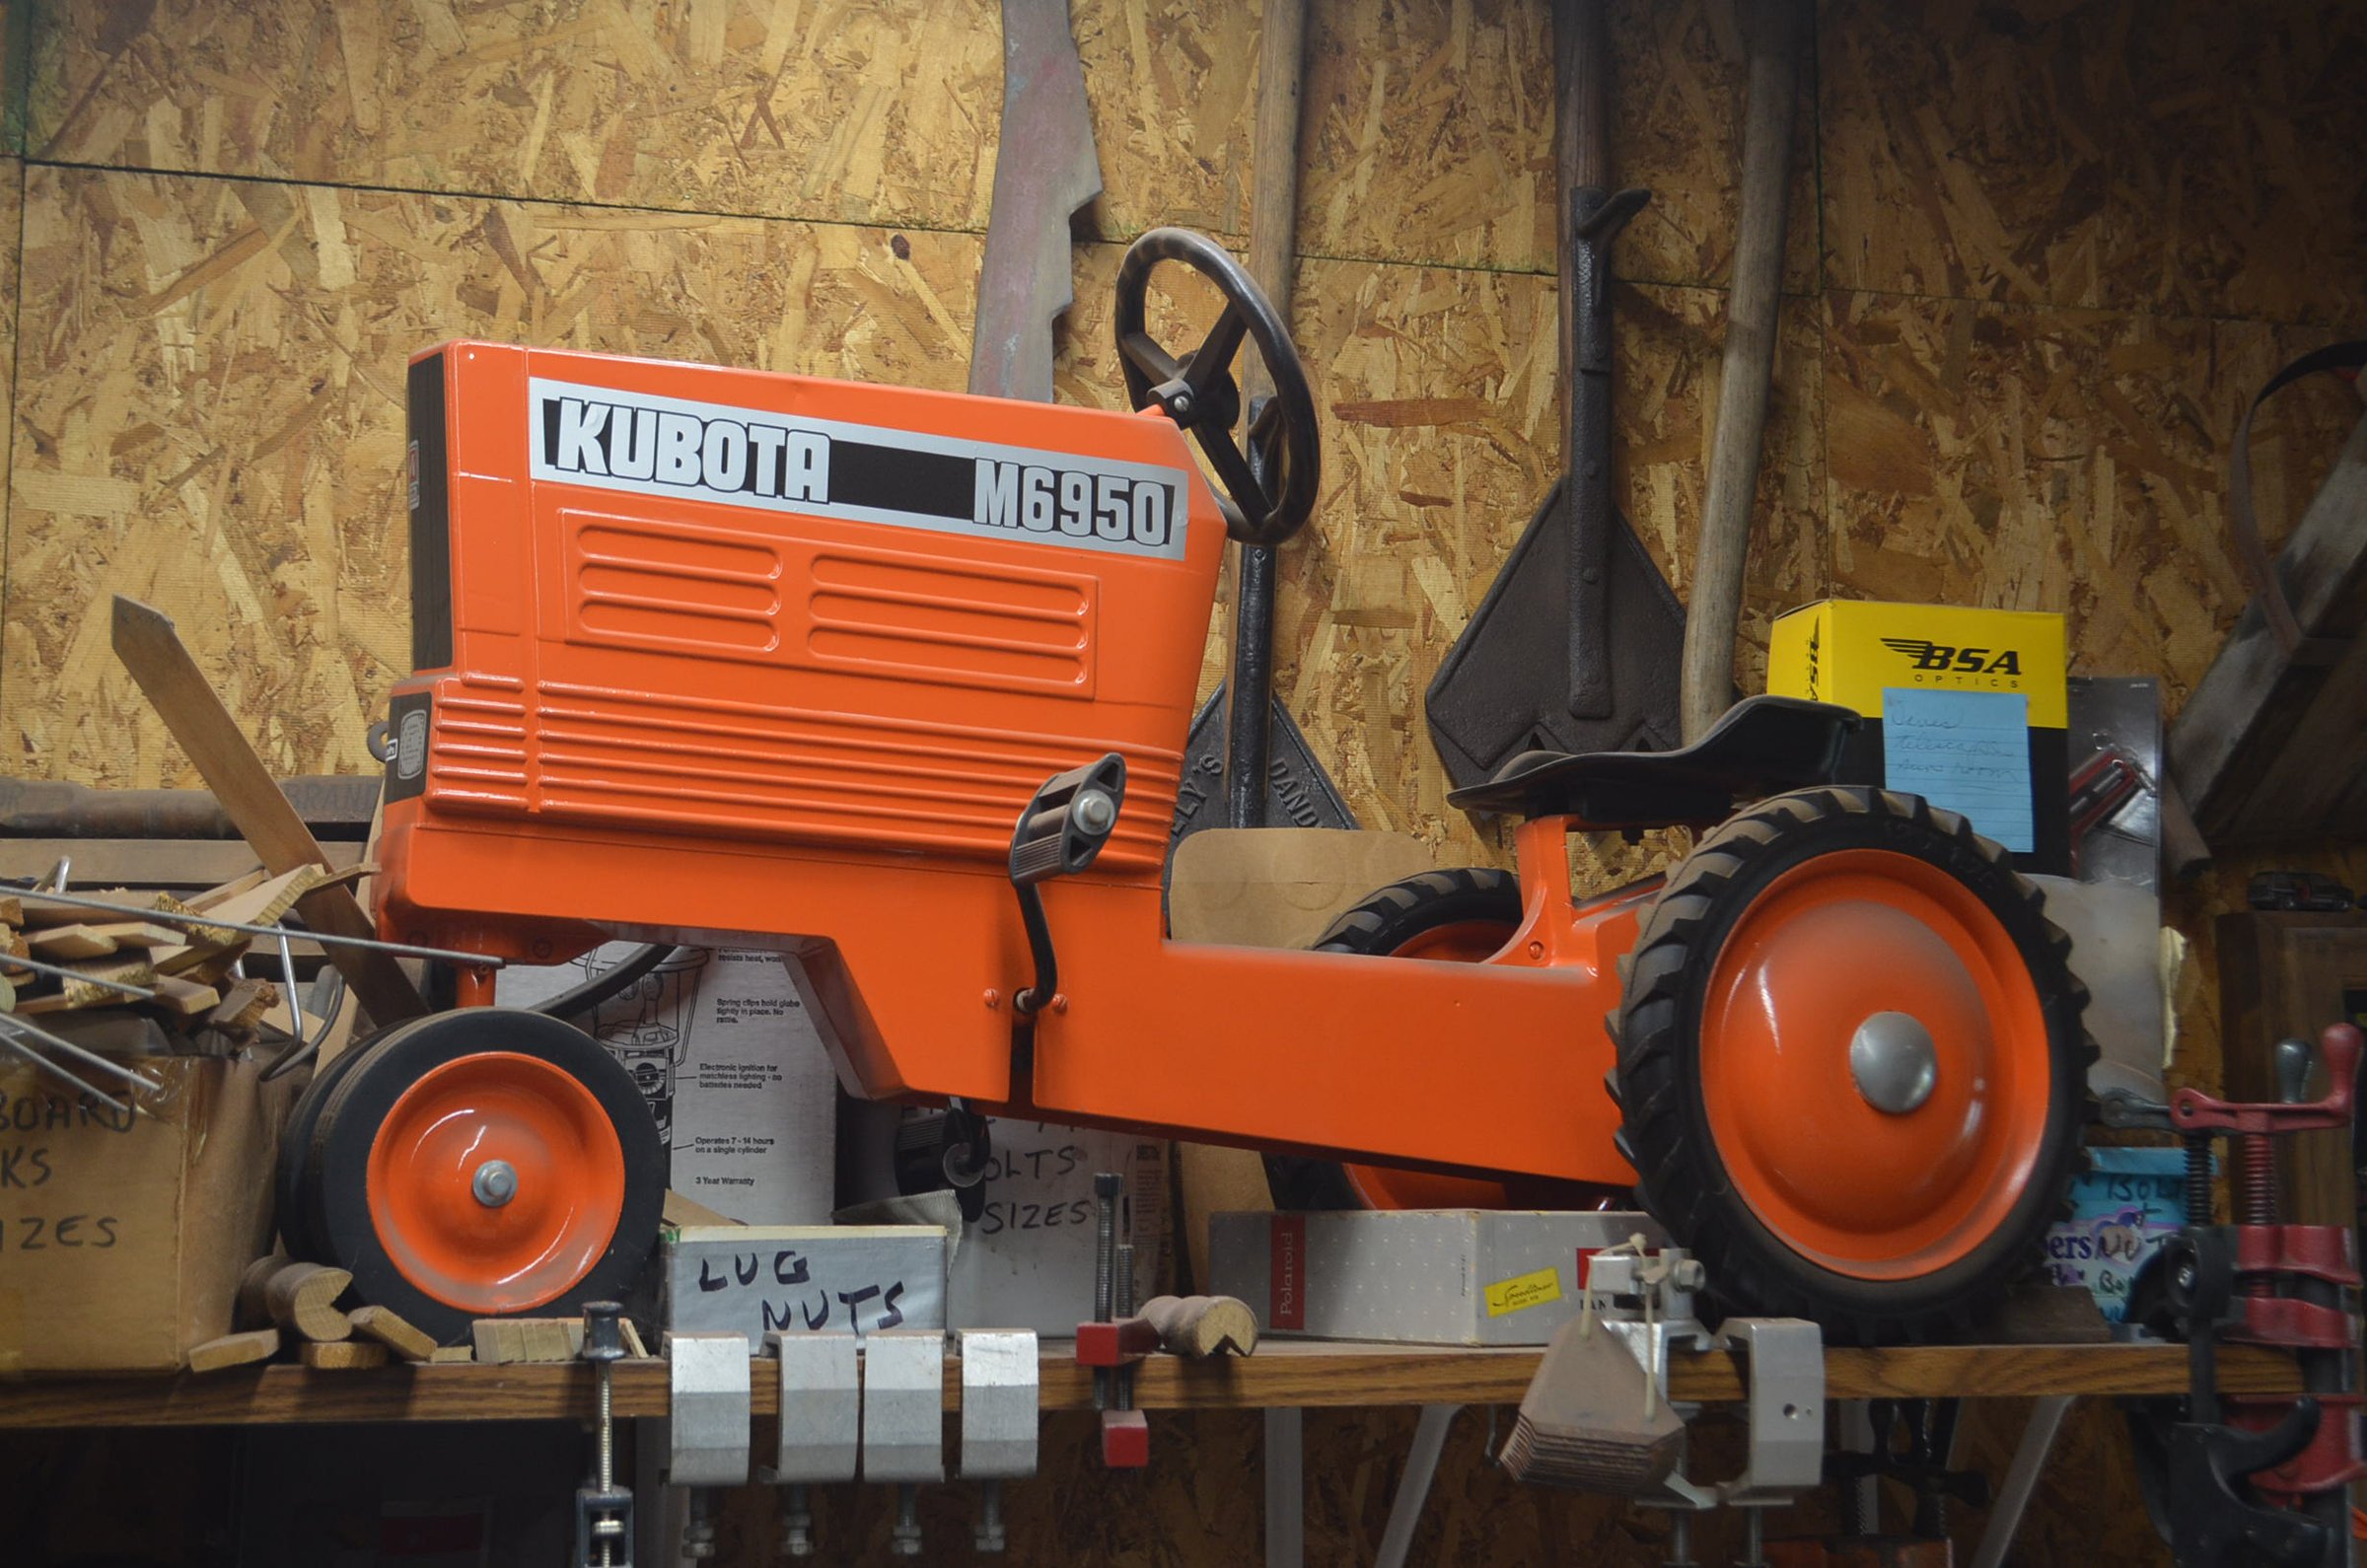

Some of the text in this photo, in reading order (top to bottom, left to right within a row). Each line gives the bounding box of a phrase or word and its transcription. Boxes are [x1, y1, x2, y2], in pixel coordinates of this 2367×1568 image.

[555, 396, 1167, 546] KUBOTA M6950
[1903, 643, 2021, 676] BSA
[1914, 674, 2019, 688] OPTICS
[1270, 756, 1323, 828] DAND
[716, 998, 800, 1009] Spring clips hold globe
[699, 1063, 737, 1072] Electronic
[739, 1064, 765, 1073] ignition
[739, 1073, 766, 1082] lighting
[695, 1137, 730, 1146] Operates
[713, 1146, 735, 1155] single
[737, 1146, 766, 1155] cylinder
[721, 1176, 755, 1186] Warranty
[981, 1199, 1092, 1234] SIZES
[2044, 1235, 2093, 1260] ers
[698, 1249, 812, 1293] LUG
[1279, 1231, 1294, 1316] Polaroid
[760, 1280, 905, 1336] NUTS
